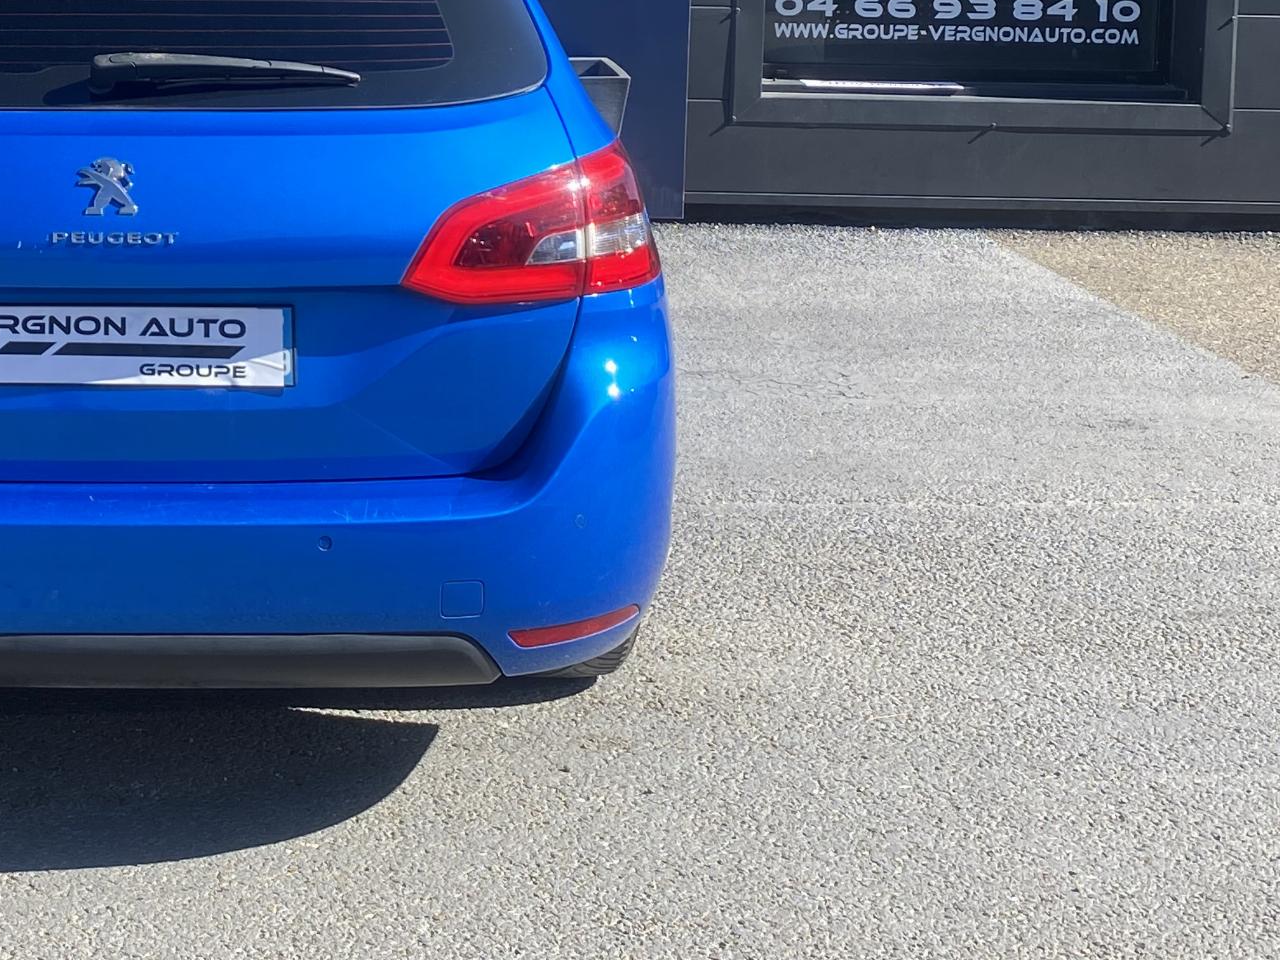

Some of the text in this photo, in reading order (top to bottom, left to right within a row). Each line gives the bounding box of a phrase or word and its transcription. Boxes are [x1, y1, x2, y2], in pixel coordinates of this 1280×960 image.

[1096, 0, 1141, 23] 10
[774, 22, 1140, 45] WWW.GROUPE-VERGNONAUTO.COM
[51, 231, 179, 245] PEUGEOT
[138, 317, 247, 339] AUTO
[138, 362, 247, 380] GROUPE
